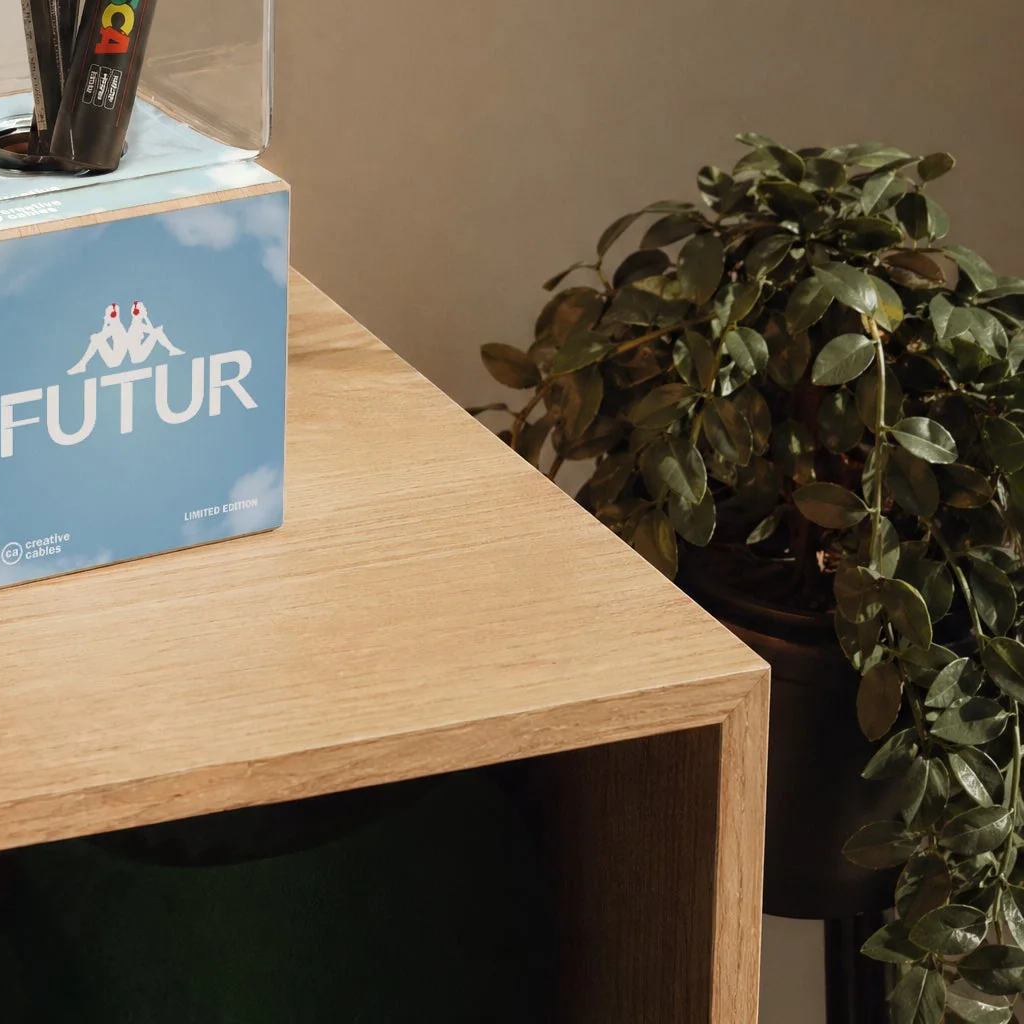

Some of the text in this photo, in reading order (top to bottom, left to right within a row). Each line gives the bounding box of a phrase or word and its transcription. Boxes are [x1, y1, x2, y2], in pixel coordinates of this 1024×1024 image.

[0, 349, 258, 458] FUTUR
[184, 498, 258, 521] LIMITED EDITION
[25, 533, 70, 549] creative
[25, 545, 62, 560] cables
